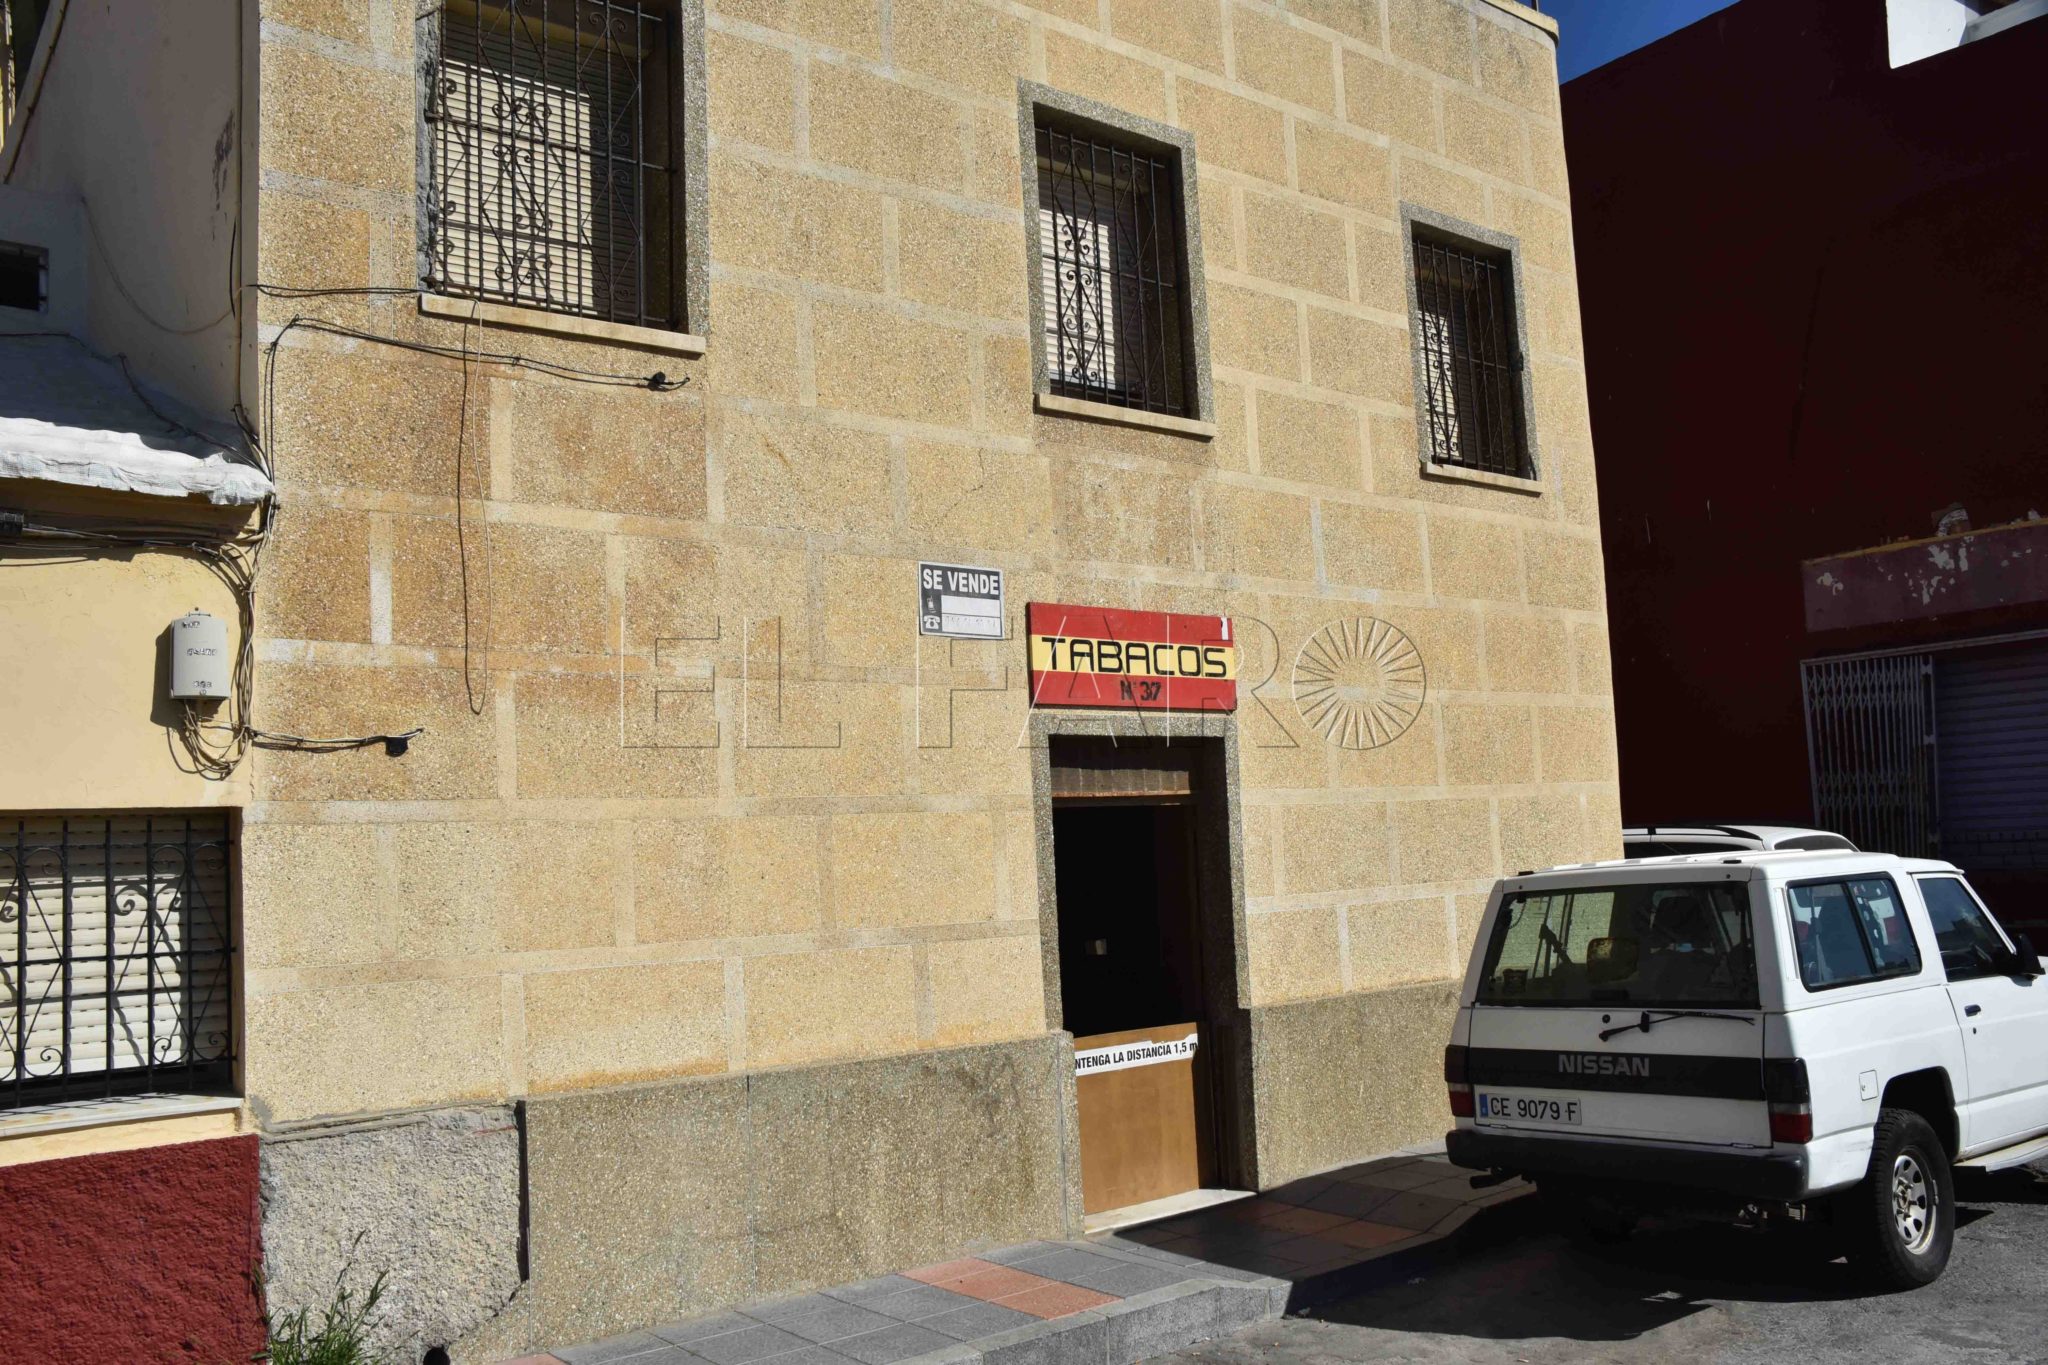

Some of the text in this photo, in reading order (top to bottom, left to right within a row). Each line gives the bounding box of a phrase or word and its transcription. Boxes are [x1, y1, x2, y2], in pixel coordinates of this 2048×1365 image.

[923, 569, 1000, 596] SE VENDE
[1041, 636, 1227, 678] TABACOS
[1140, 681, 1161, 701] 37
[1113, 1051, 1125, 1064] LA
[1127, 1043, 1172, 1061] DISTANCIA
[1174, 1041, 1187, 1055] 1,5
[1558, 1054, 1650, 1077] NISSAN
[1490, 1097, 1577, 1121] CE 9079 F
